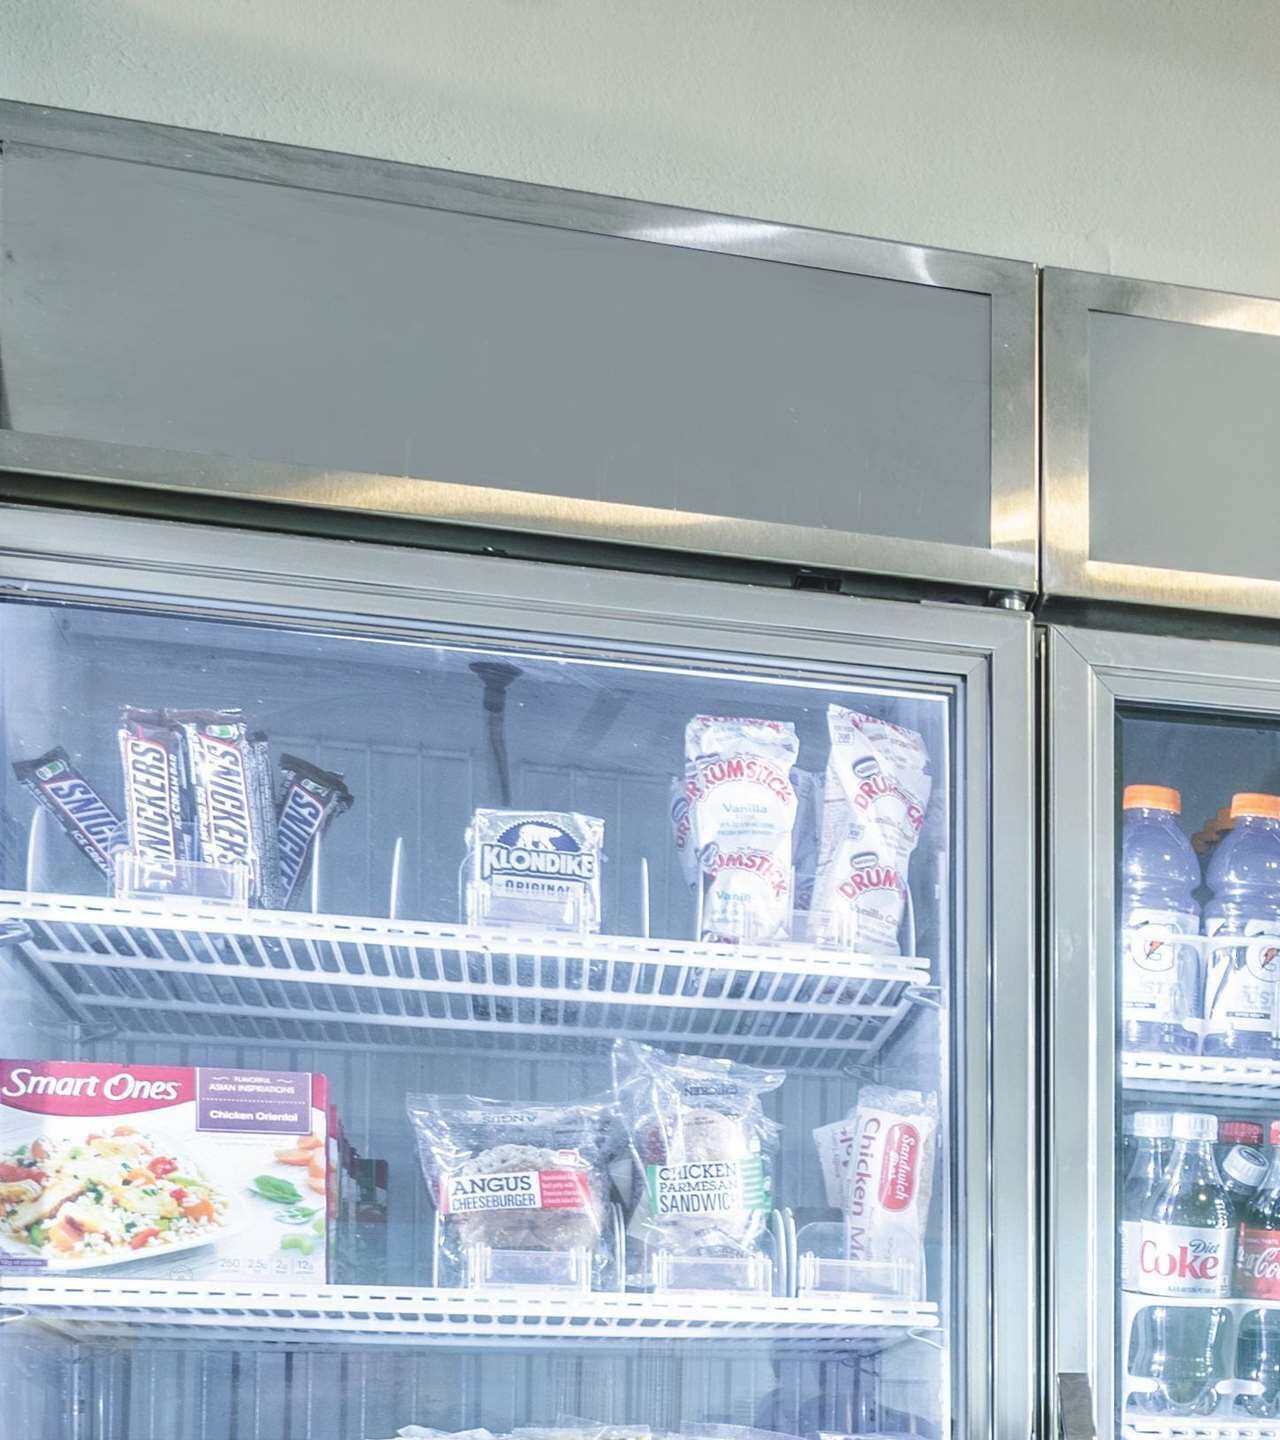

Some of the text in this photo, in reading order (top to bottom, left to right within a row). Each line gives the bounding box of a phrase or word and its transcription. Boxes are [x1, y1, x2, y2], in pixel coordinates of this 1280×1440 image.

[482, 843, 595, 879] KLONDIKE
[2, 1069, 183, 1100] Smart Ones
[209, 1083, 236, 1093] ASIAN
[210, 1110, 298, 1122] Chicken Oriental
[658, 1161, 736, 1182] CHICKEN
[852, 1117, 880, 1216] Chicken
[454, 1175, 532, 1195] ANGUS
[659, 1179, 736, 1194] PARMESAN
[451, 1192, 536, 1211] CHEESEBURGER
[1140, 1240, 1220, 1280] Coke
